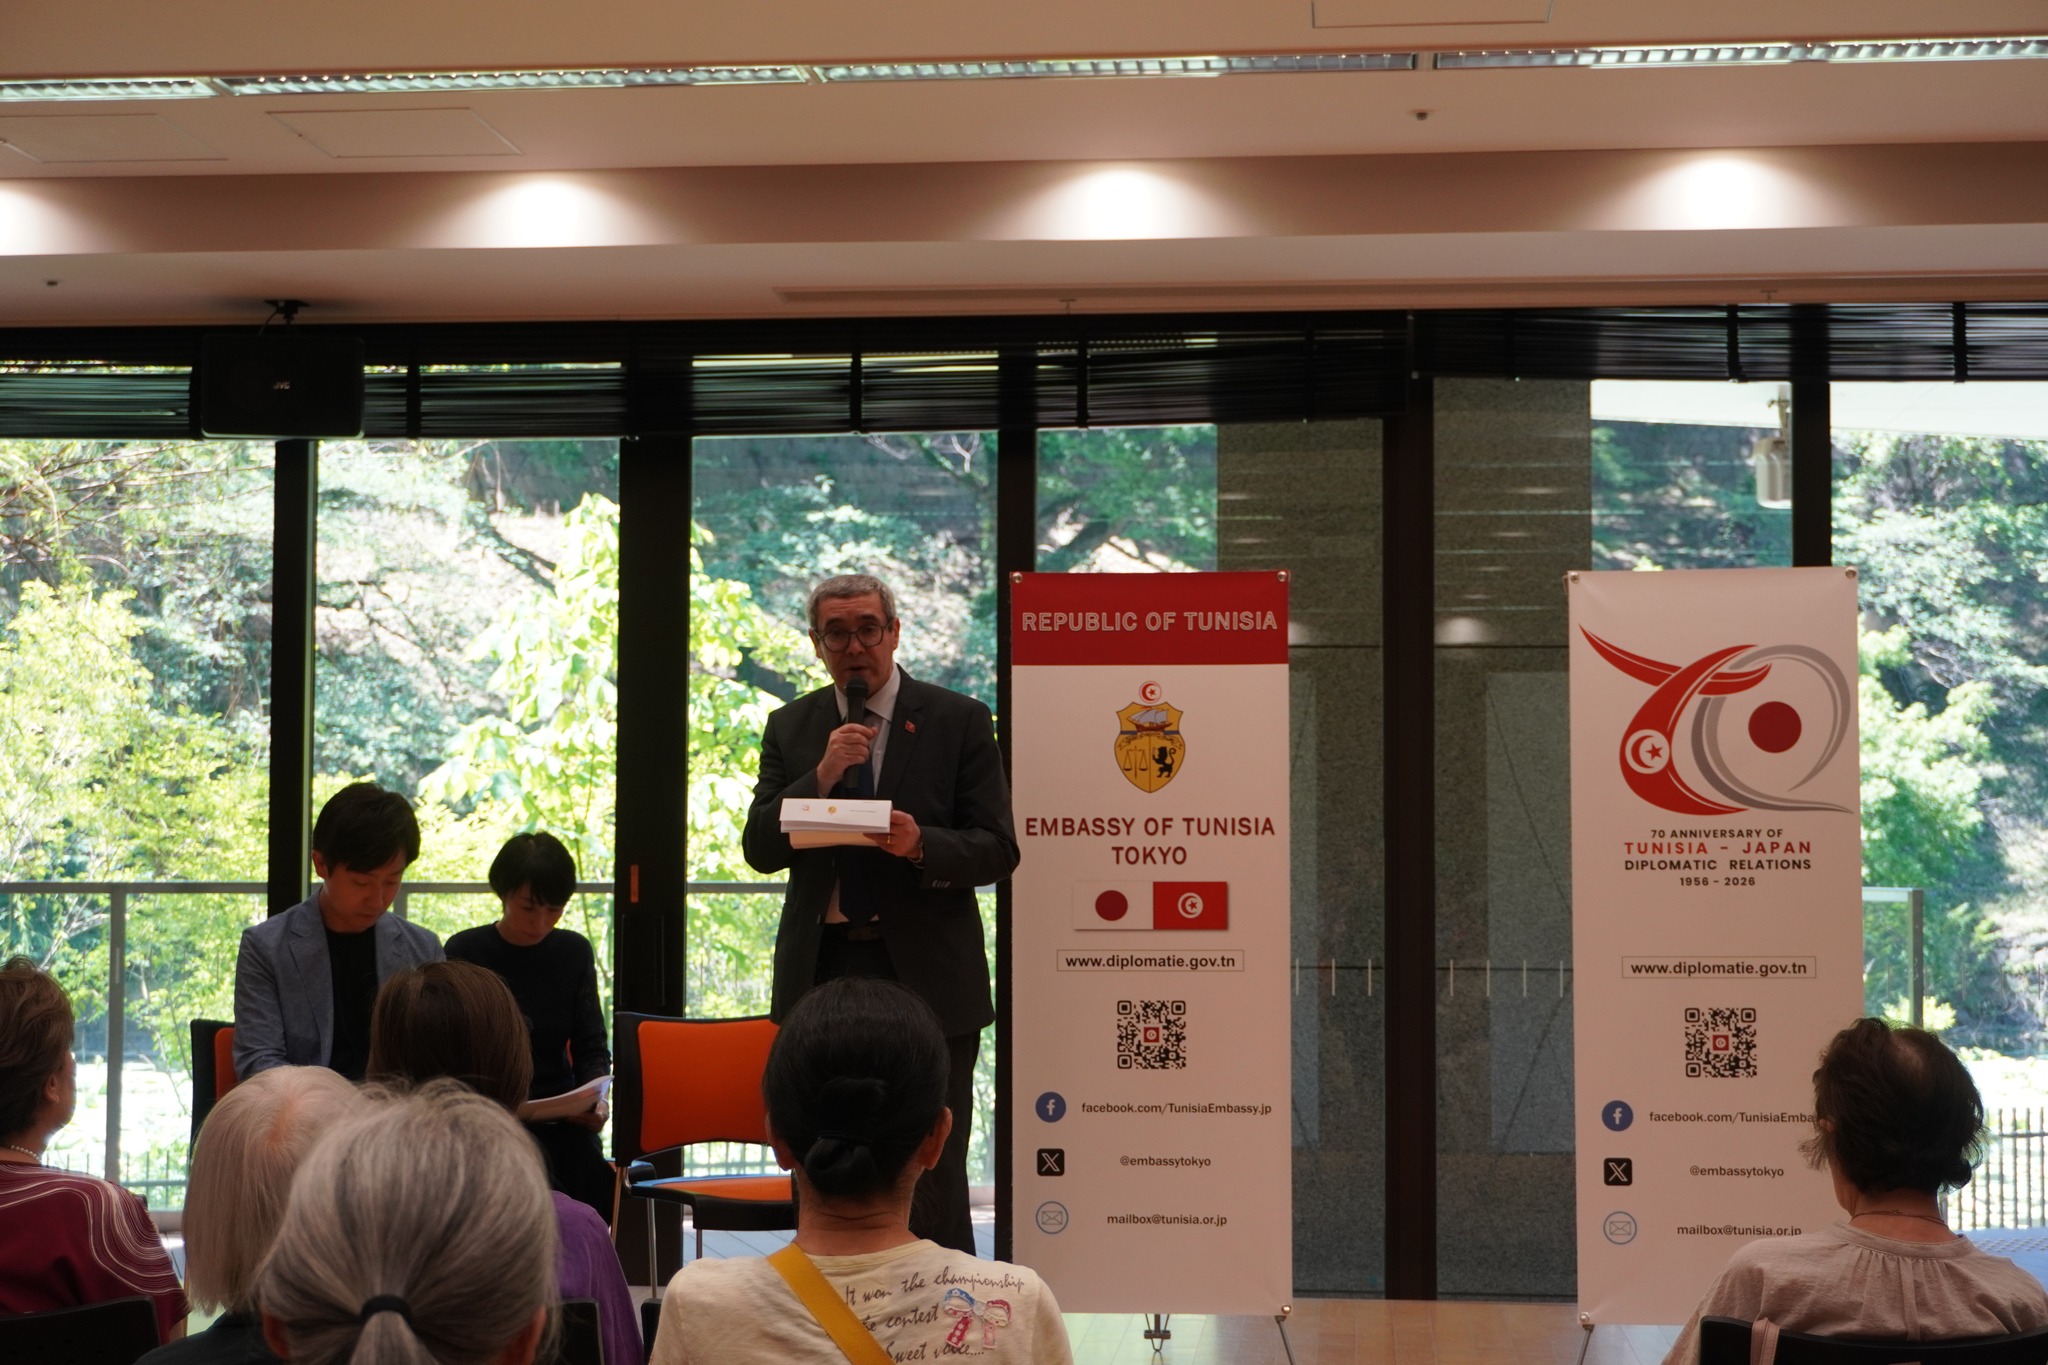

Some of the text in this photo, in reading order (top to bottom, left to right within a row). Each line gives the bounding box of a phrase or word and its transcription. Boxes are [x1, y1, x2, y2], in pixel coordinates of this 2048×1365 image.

[273, 381, 291, 390] JVC
[1022, 610, 1278, 632] REPUBLIC OF TUNISIA
[1025, 816, 1275, 837] EMBASSY OF TUNISIA
[1650, 828, 1784, 839] 70 ANNIVERSARY OF
[1624, 842, 1708, 855] TUNISIA
[1742, 841, 1811, 854] JAPAN
[1111, 846, 1188, 865] TOKYO
[1624, 859, 1812, 871] DIPLOMATIC RELATIONS
[1679, 876, 1710, 887] 1956
[1724, 876, 1756, 887] 2026
[1065, 954, 1236, 970] www.diplomatie.gov.tn
[1630, 961, 1807, 977] www.diplomatie.gov.tn
[1081, 1102, 1272, 1116] facebook.com/TunisiaEmbassy.jp
[1649, 1111, 1815, 1124] facebook.com/TunisiaEmba
[1119, 1155, 1212, 1169] @embassytokyo
[1689, 1165, 1785, 1178] @embassytokyo
[1106, 1213, 1228, 1227] mailbox@tunisia.or.jp
[862, 1288, 893, 1303] won
[901, 1272, 926, 1293] the
[933, 1266, 1026, 1294] championship
[886, 1303, 939, 1328] contest
